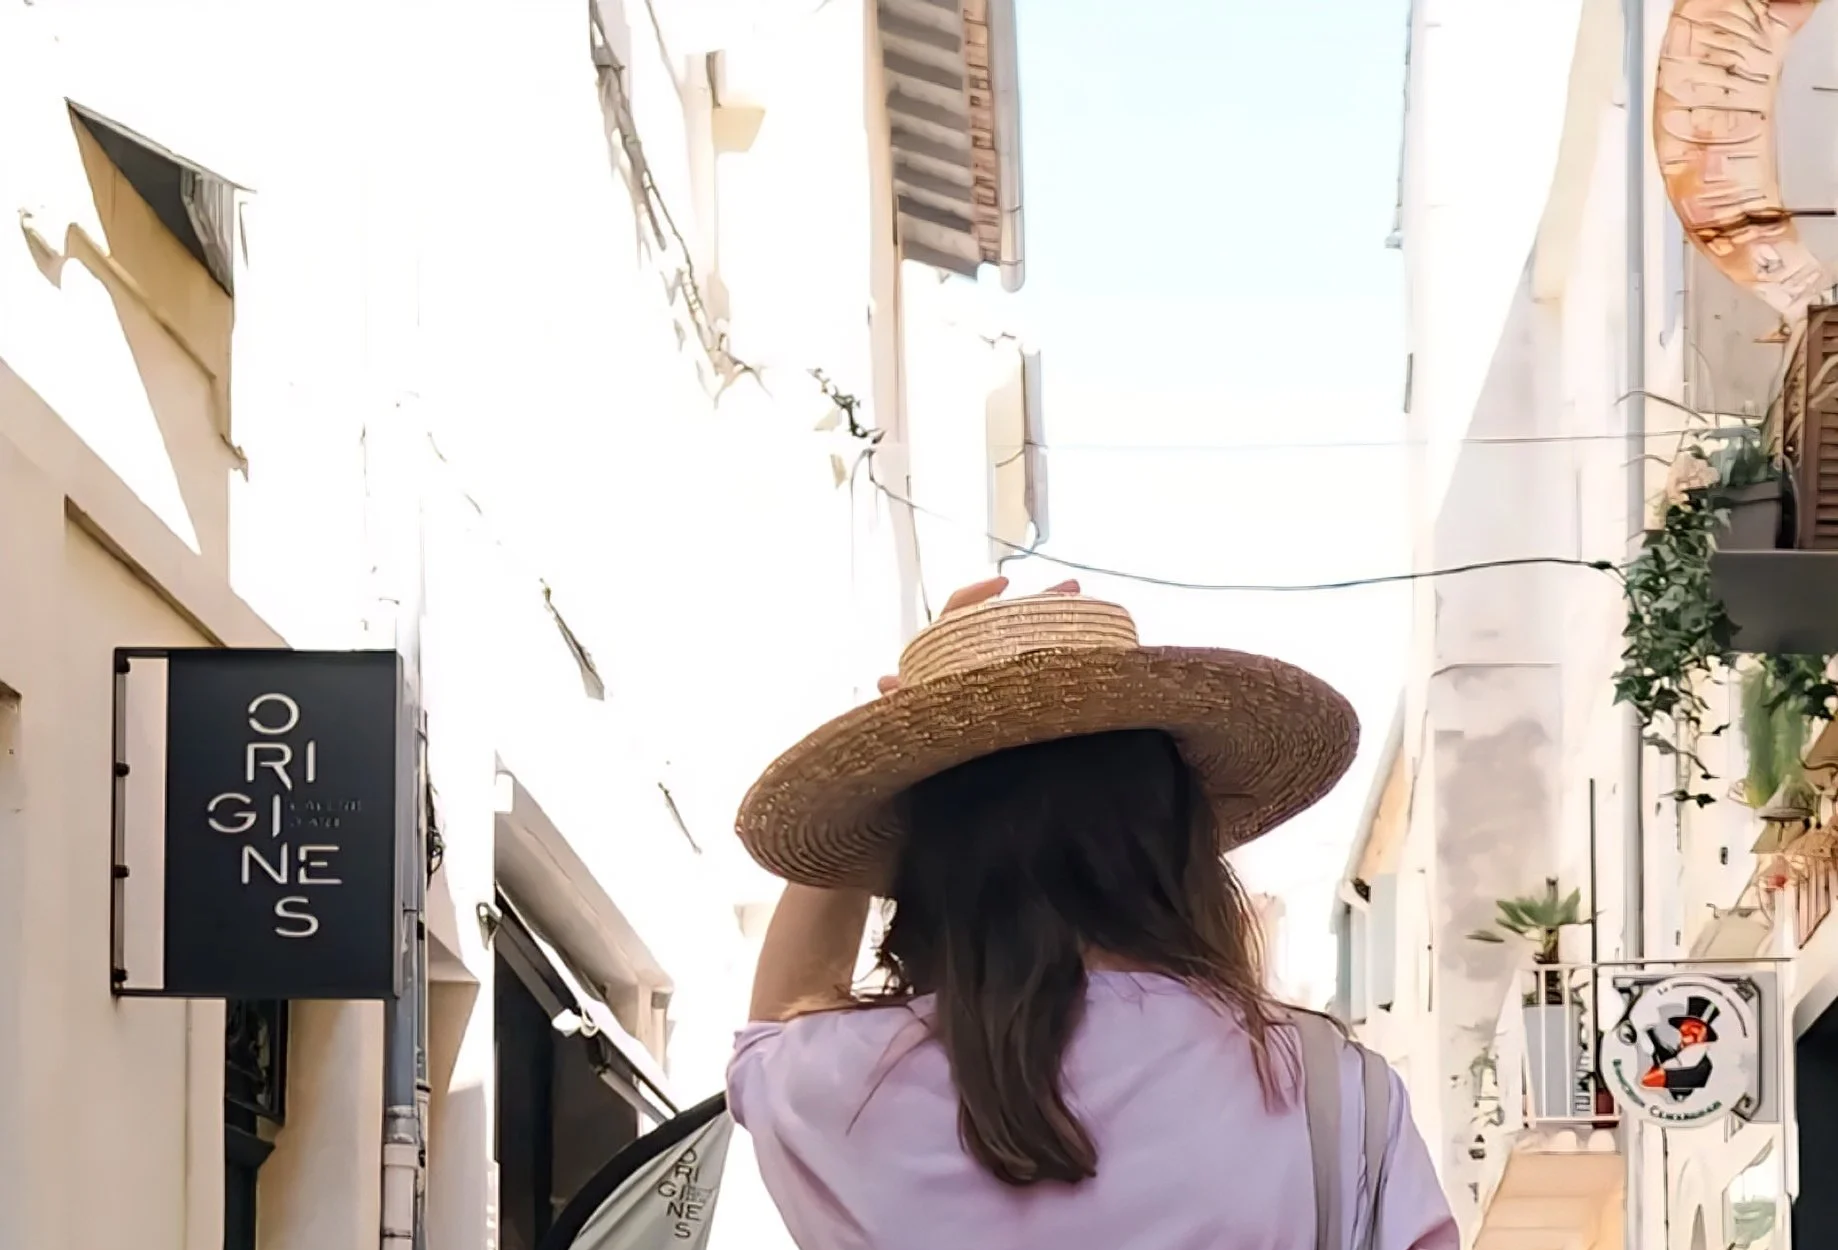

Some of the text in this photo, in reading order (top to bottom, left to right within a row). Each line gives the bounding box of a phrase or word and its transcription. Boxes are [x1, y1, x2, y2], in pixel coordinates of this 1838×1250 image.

[248, 692, 300, 735] O
[245, 740, 317, 791] RI
[207, 792, 281, 838] GI
[241, 842, 342, 885] NE
[274, 896, 320, 938] S
[657, 1181, 686, 1200] GI
[666, 1201, 703, 1221] NE
[674, 1222, 691, 1239] S
